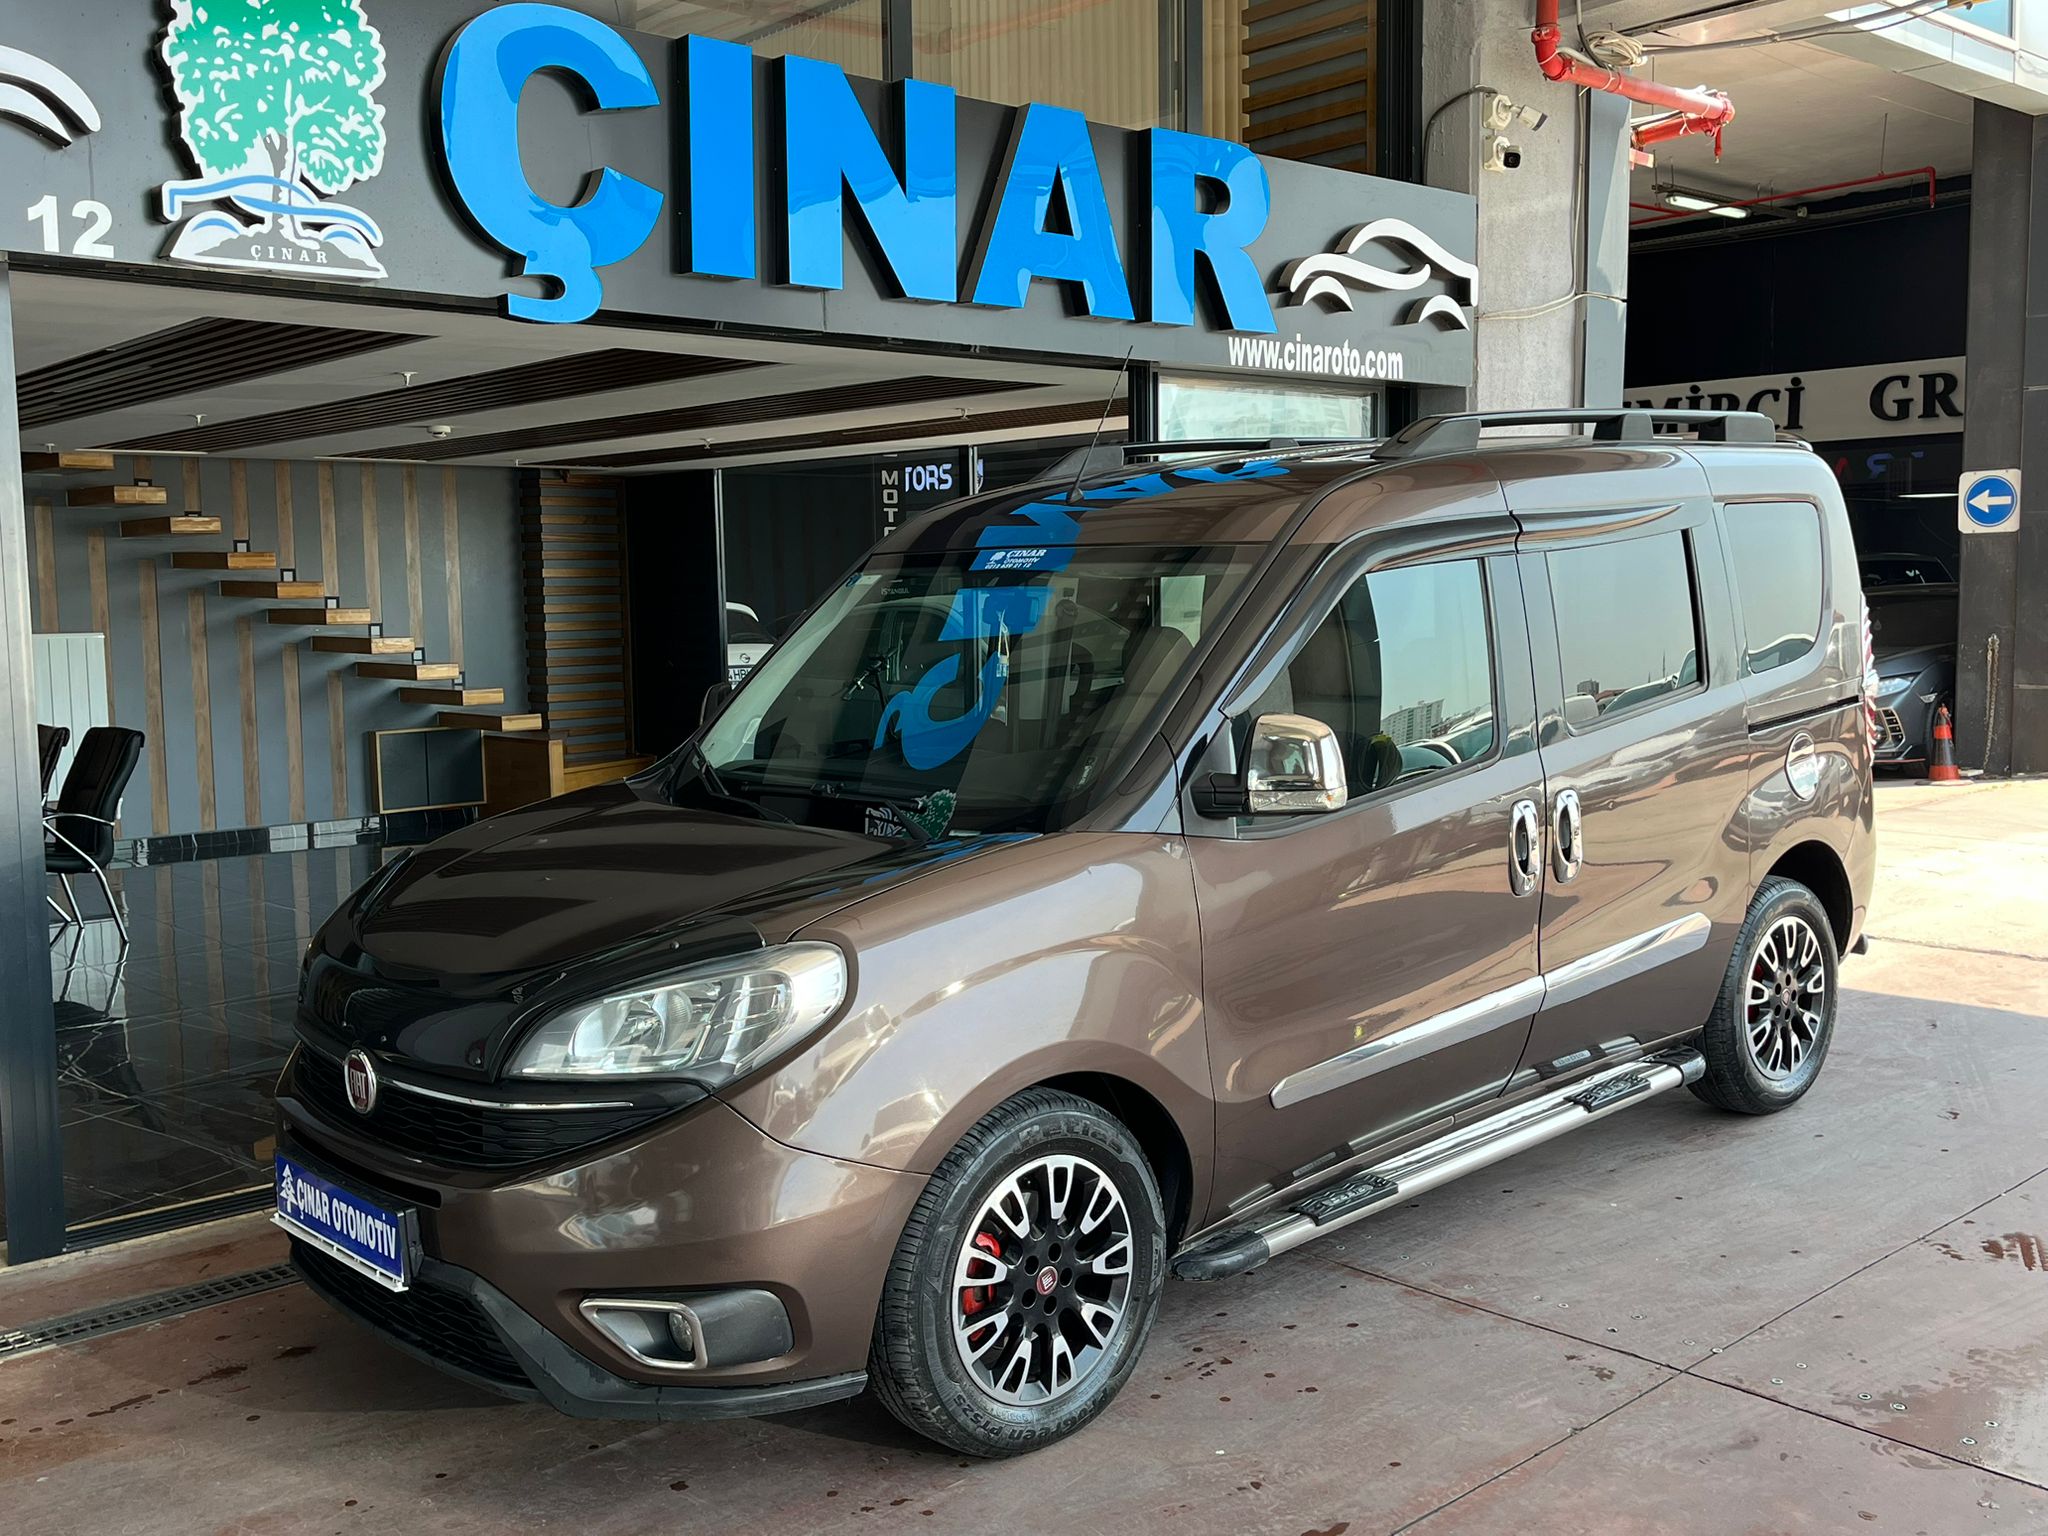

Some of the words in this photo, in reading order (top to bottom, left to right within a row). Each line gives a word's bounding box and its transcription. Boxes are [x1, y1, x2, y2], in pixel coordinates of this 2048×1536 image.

[441, 3, 1277, 333] ÇINAR
[27, 195, 115, 259] 12
[249, 243, 328, 265] ÇINAR
[1228, 336, 1404, 380] www.cinaroto.com
[1869, 372, 1964, 422] GR
[350, 1070, 366, 1099] FIAT
[297, 1178, 331, 1226] ÇINAR
[332, 1197, 396, 1259] OTOMOTİV
